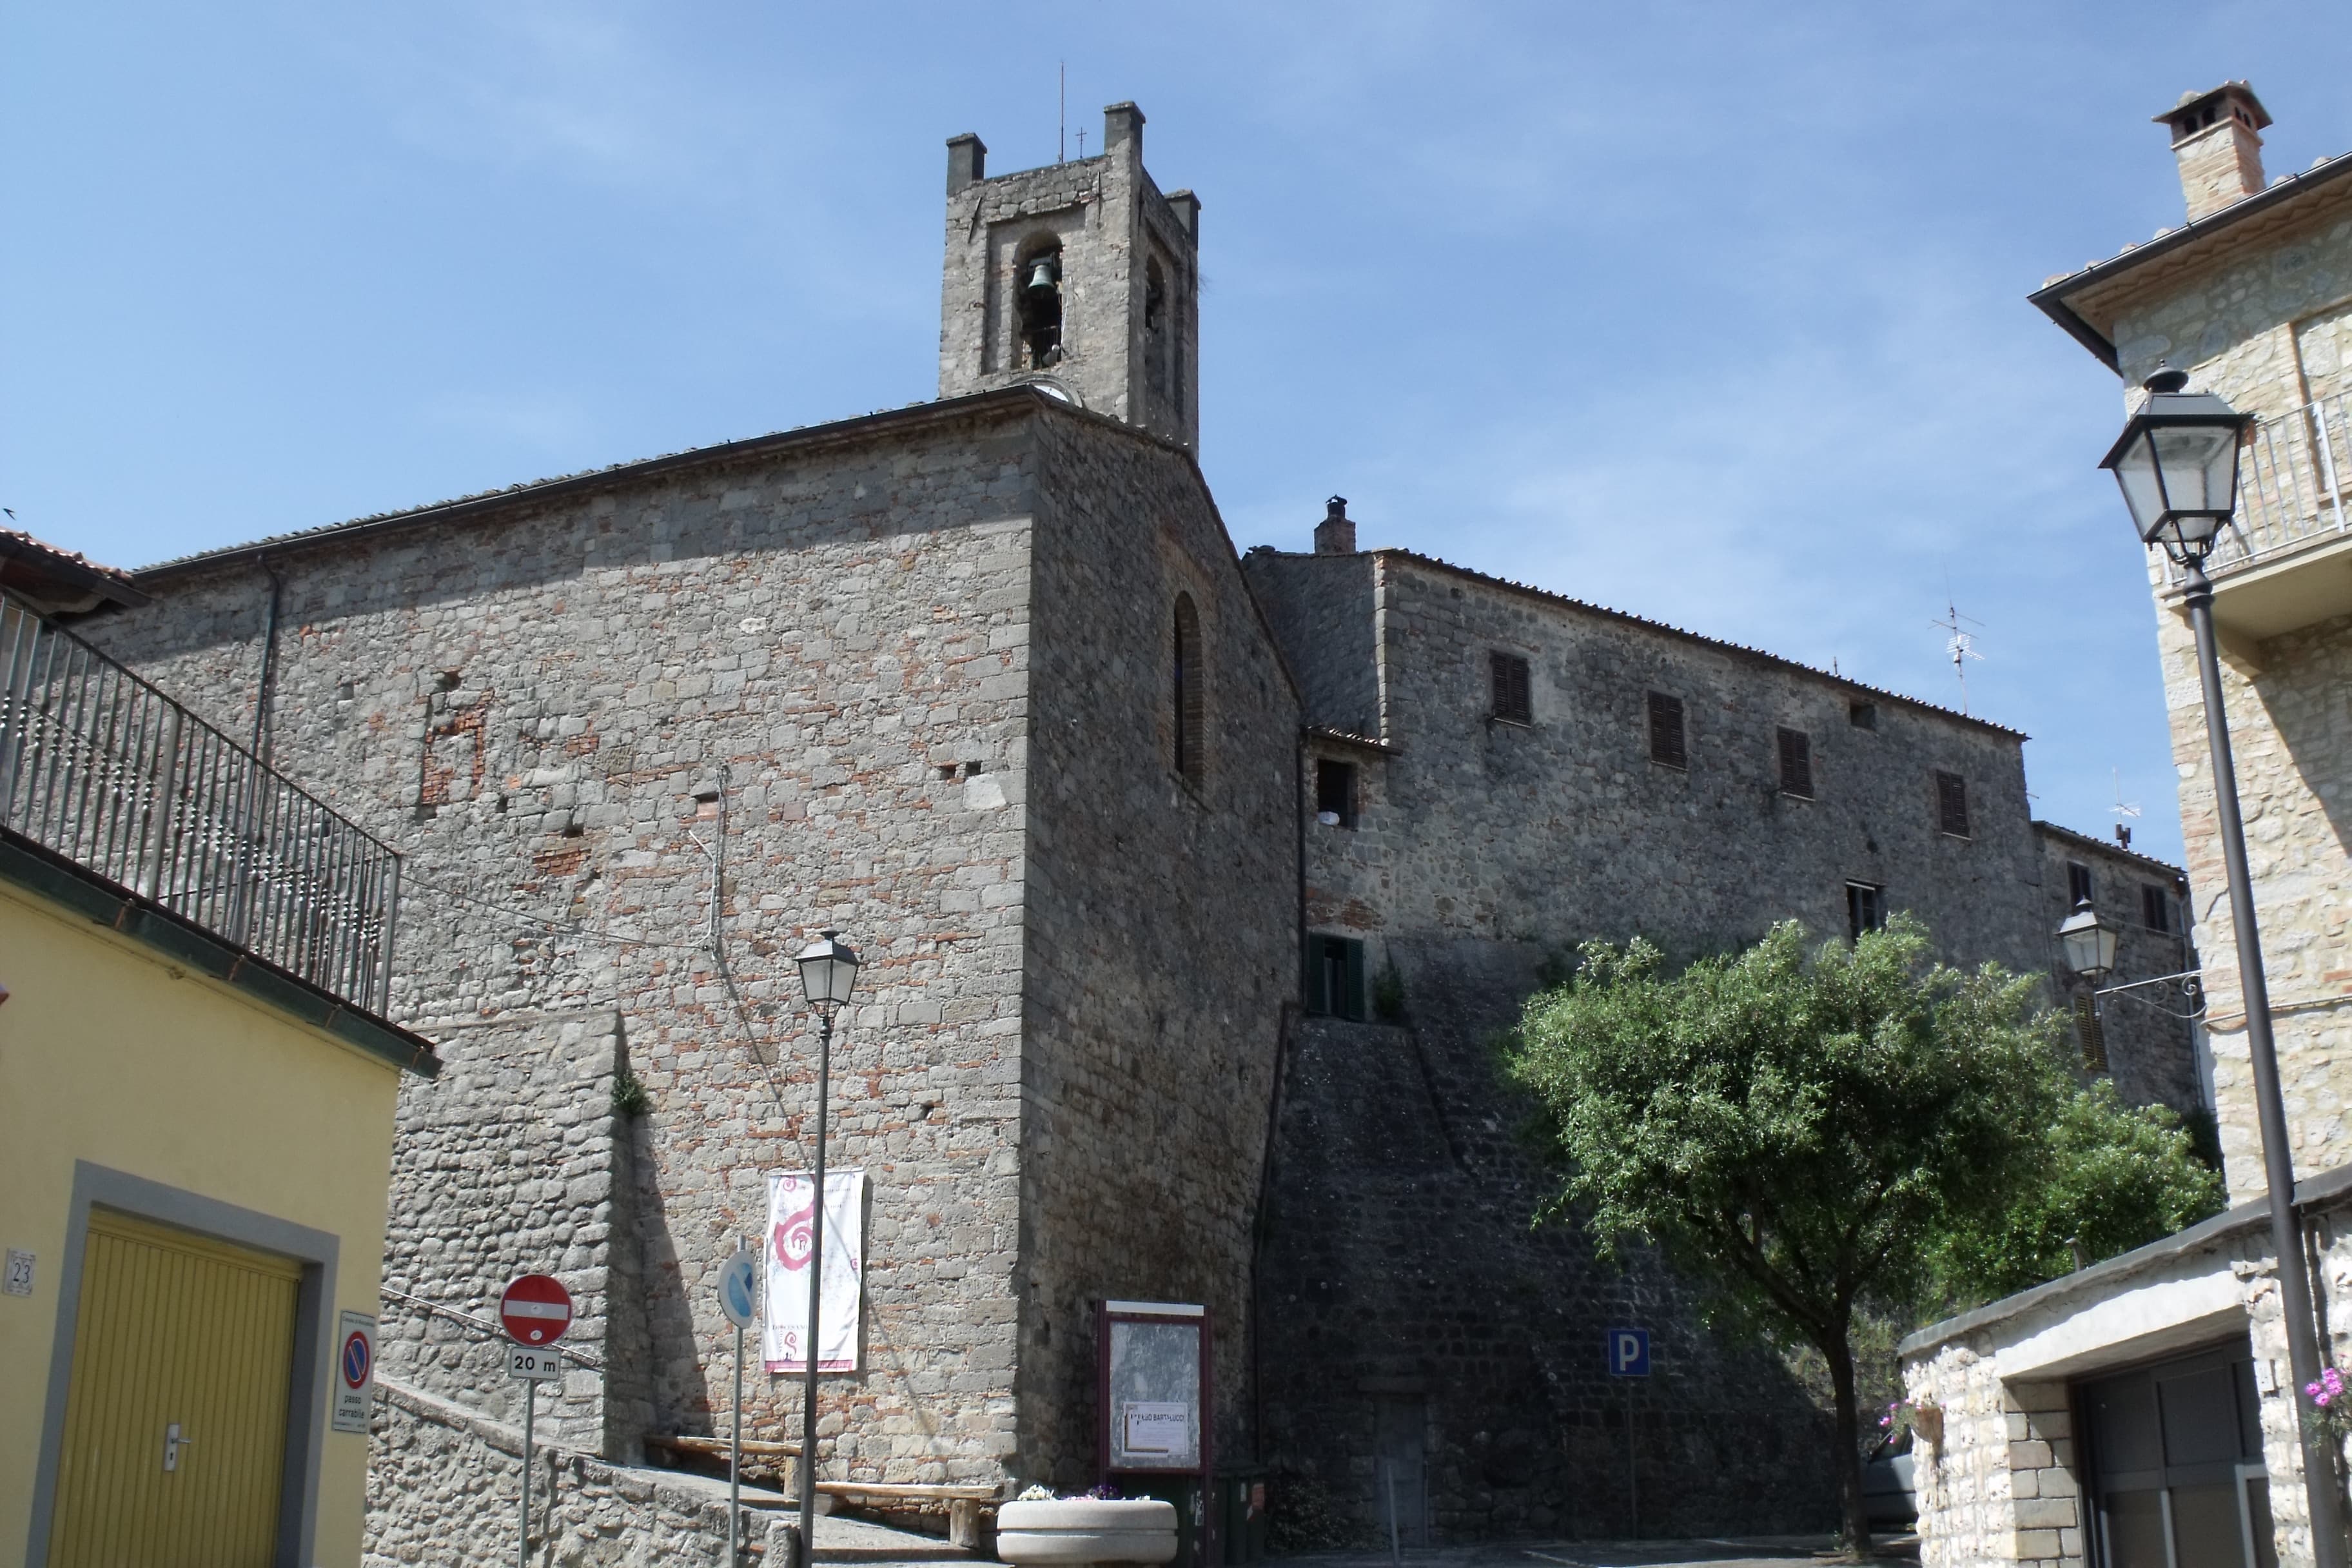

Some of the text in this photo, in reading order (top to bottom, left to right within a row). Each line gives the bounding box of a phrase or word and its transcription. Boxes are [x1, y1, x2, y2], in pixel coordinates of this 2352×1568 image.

[14, 1262, 30, 1284] 23
[1619, 1334, 1640, 1371] P
[514, 1355, 556, 1372] 20 m
[344, 1395, 362, 1405] passo
[339, 1408, 365, 1419] carrabile
